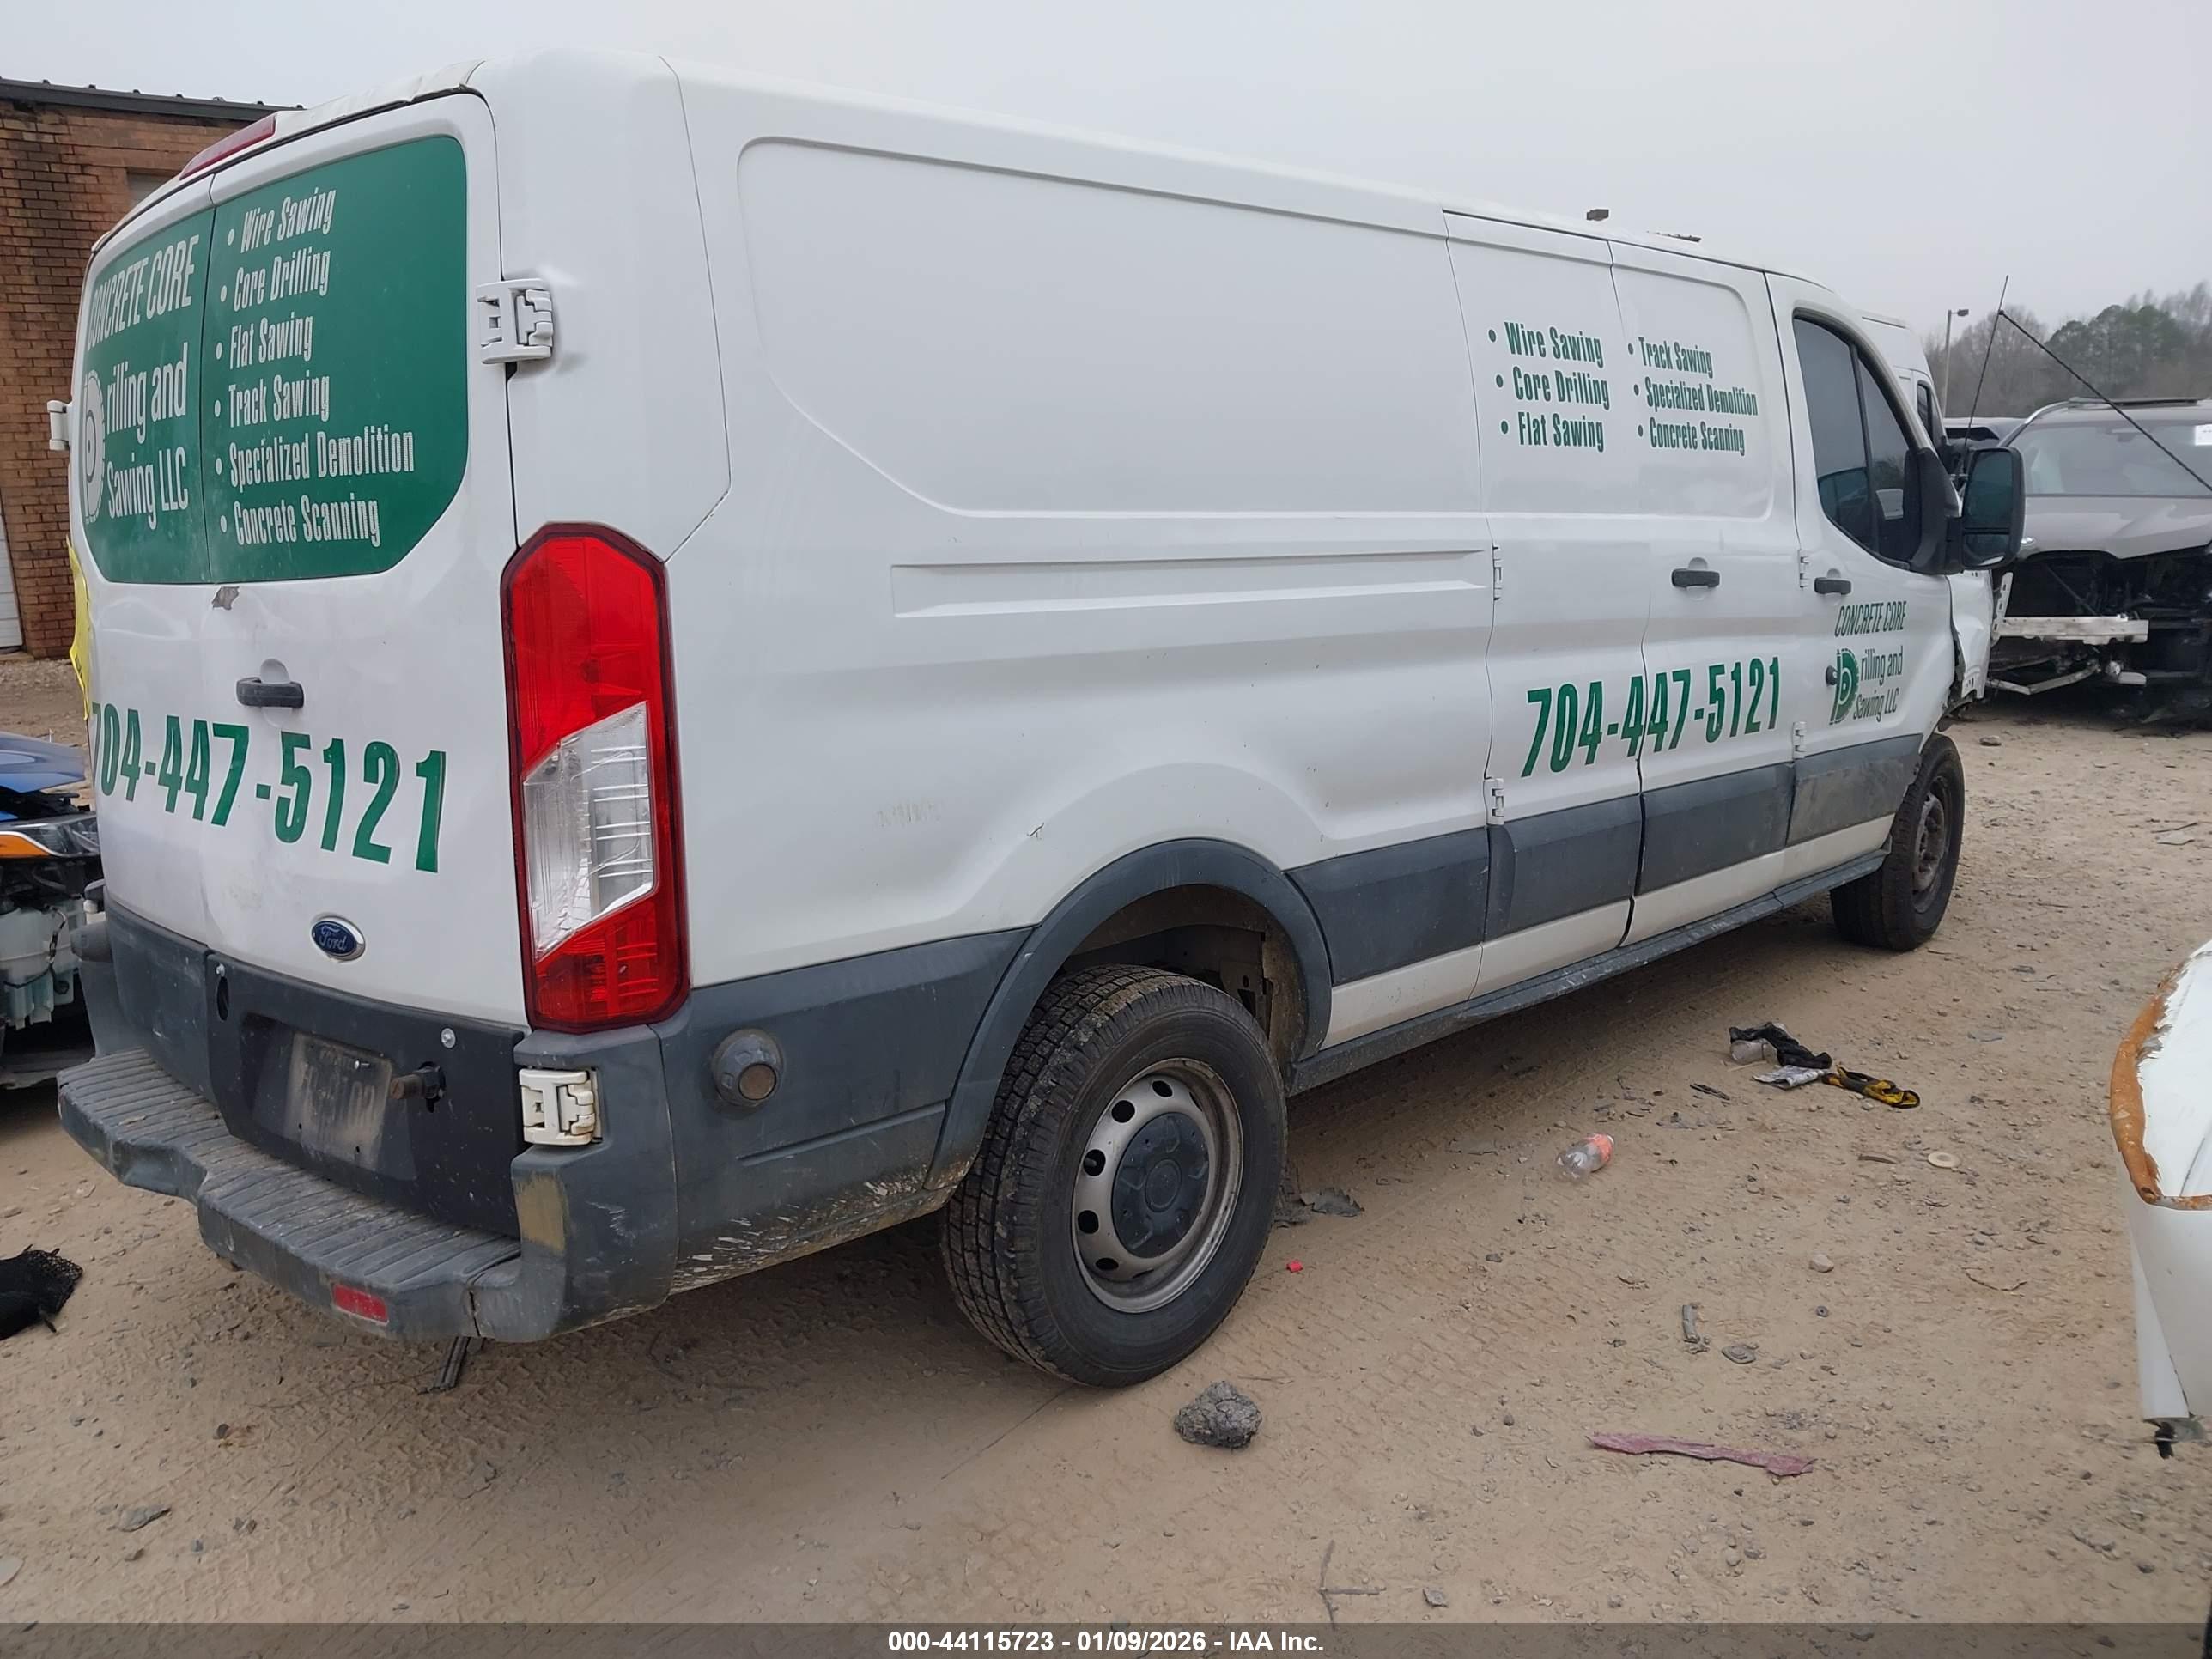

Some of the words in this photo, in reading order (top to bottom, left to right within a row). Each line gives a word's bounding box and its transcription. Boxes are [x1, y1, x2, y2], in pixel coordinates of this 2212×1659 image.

[240, 207, 275, 253] Wire
[276, 187, 336, 234] Sawing
[147, 234, 199, 319] CORE
[234, 267, 265, 312] Core
[270, 247, 331, 296] Drilling
[229, 323, 254, 370] Flat
[258, 311, 313, 362] Sawing
[1504, 322, 1547, 357] Wire
[1549, 326, 1604, 368] Sawing
[1638, 337, 1674, 369] Track
[1674, 342, 1714, 379] Sawing
[151, 342, 188, 422] and
[228, 384, 267, 428] Track
[273, 369, 330, 422] Sawing
[1512, 366, 1551, 401] Core
[1554, 370, 1610, 410] Drilling
[1644, 377, 1705, 412] Specialized
[1706, 384, 1759, 416] Demolition
[1517, 412, 1548, 446] Flat
[1552, 413, 1604, 453] Sawing
[1649, 417, 1698, 450] Concrete
[1699, 421, 1746, 456] Scanning
[229, 433, 310, 493] Specialized
[317, 424, 414, 478] Demolition
[107, 453, 156, 530] Sawing
[159, 447, 188, 510] LLC
[234, 499, 297, 545] Concrete
[301, 492, 380, 547] Scanning
[1834, 603, 1884, 637] CONCRETE
[1883, 601, 1907, 632] CORE
[1887, 645, 1904, 677] and
[1521, 656, 1780, 777] 704-447-5121
[1852, 690, 1885, 722] Sawing
[1884, 687, 1899, 714] LLC
[319, 925, 348, 951] Ford
